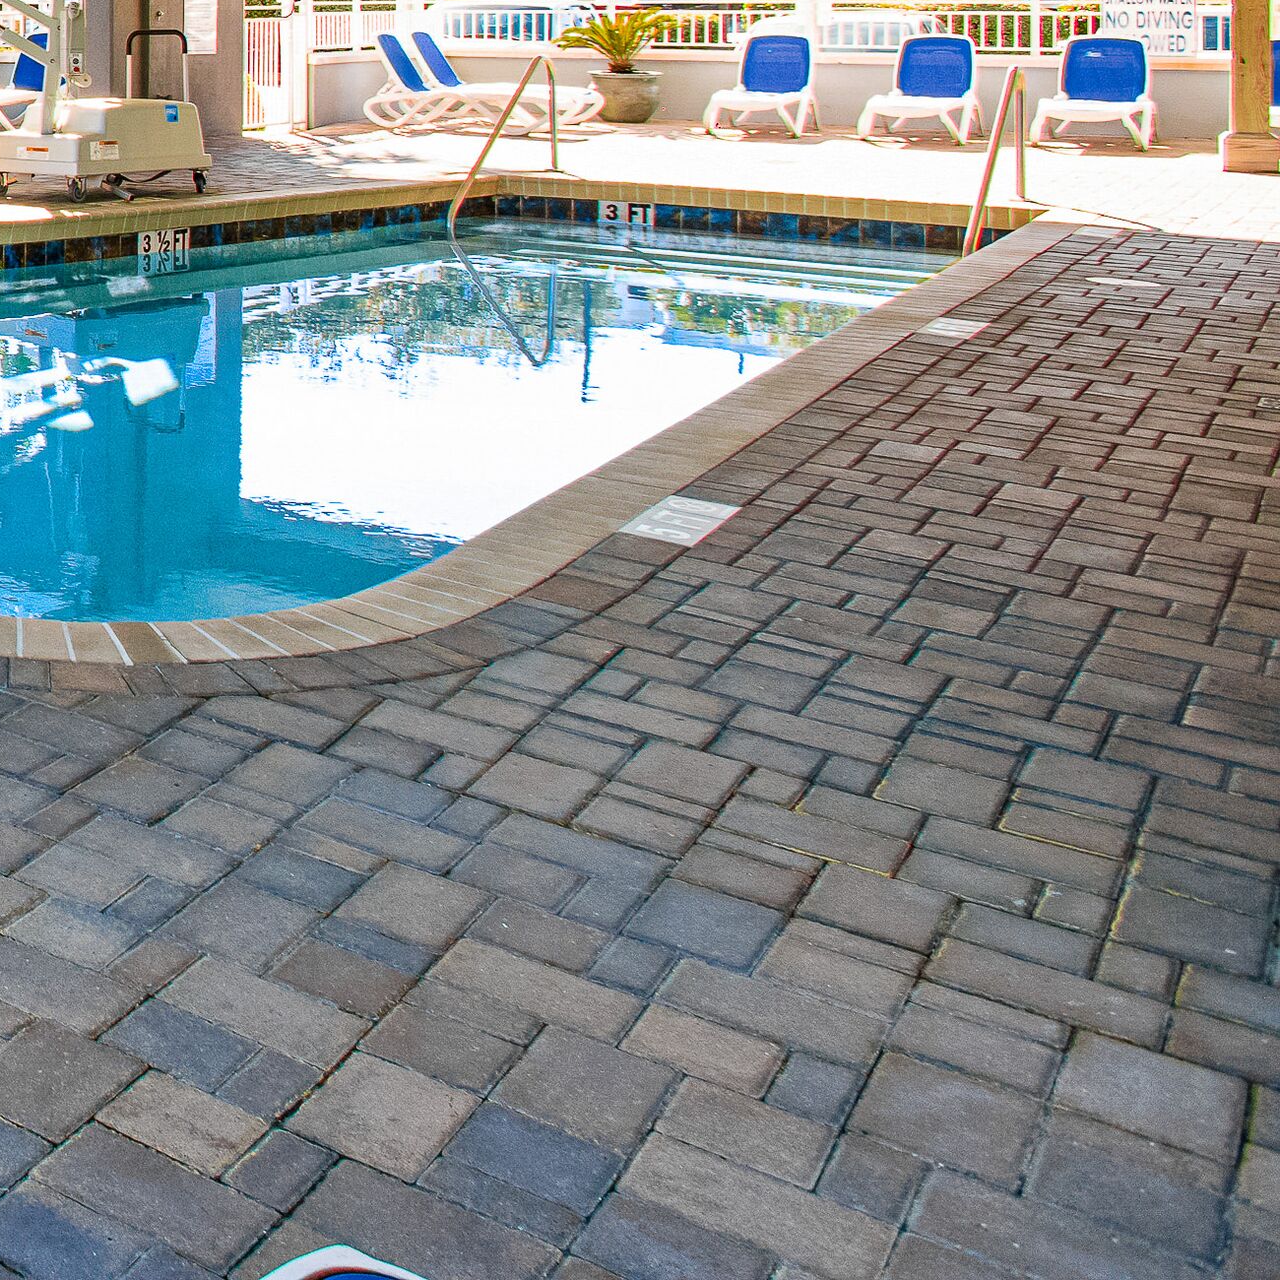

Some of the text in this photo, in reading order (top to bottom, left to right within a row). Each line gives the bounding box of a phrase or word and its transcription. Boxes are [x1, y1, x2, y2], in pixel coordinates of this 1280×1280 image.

[1105, 11, 1193, 29] NO DIVING
[1134, 34, 1187, 53] OWED
[605, 203, 652, 224] 3 FT
[143, 234, 151, 253] 3
[173, 228, 188, 252] FT
[635, 510, 711, 539] 5 FT
